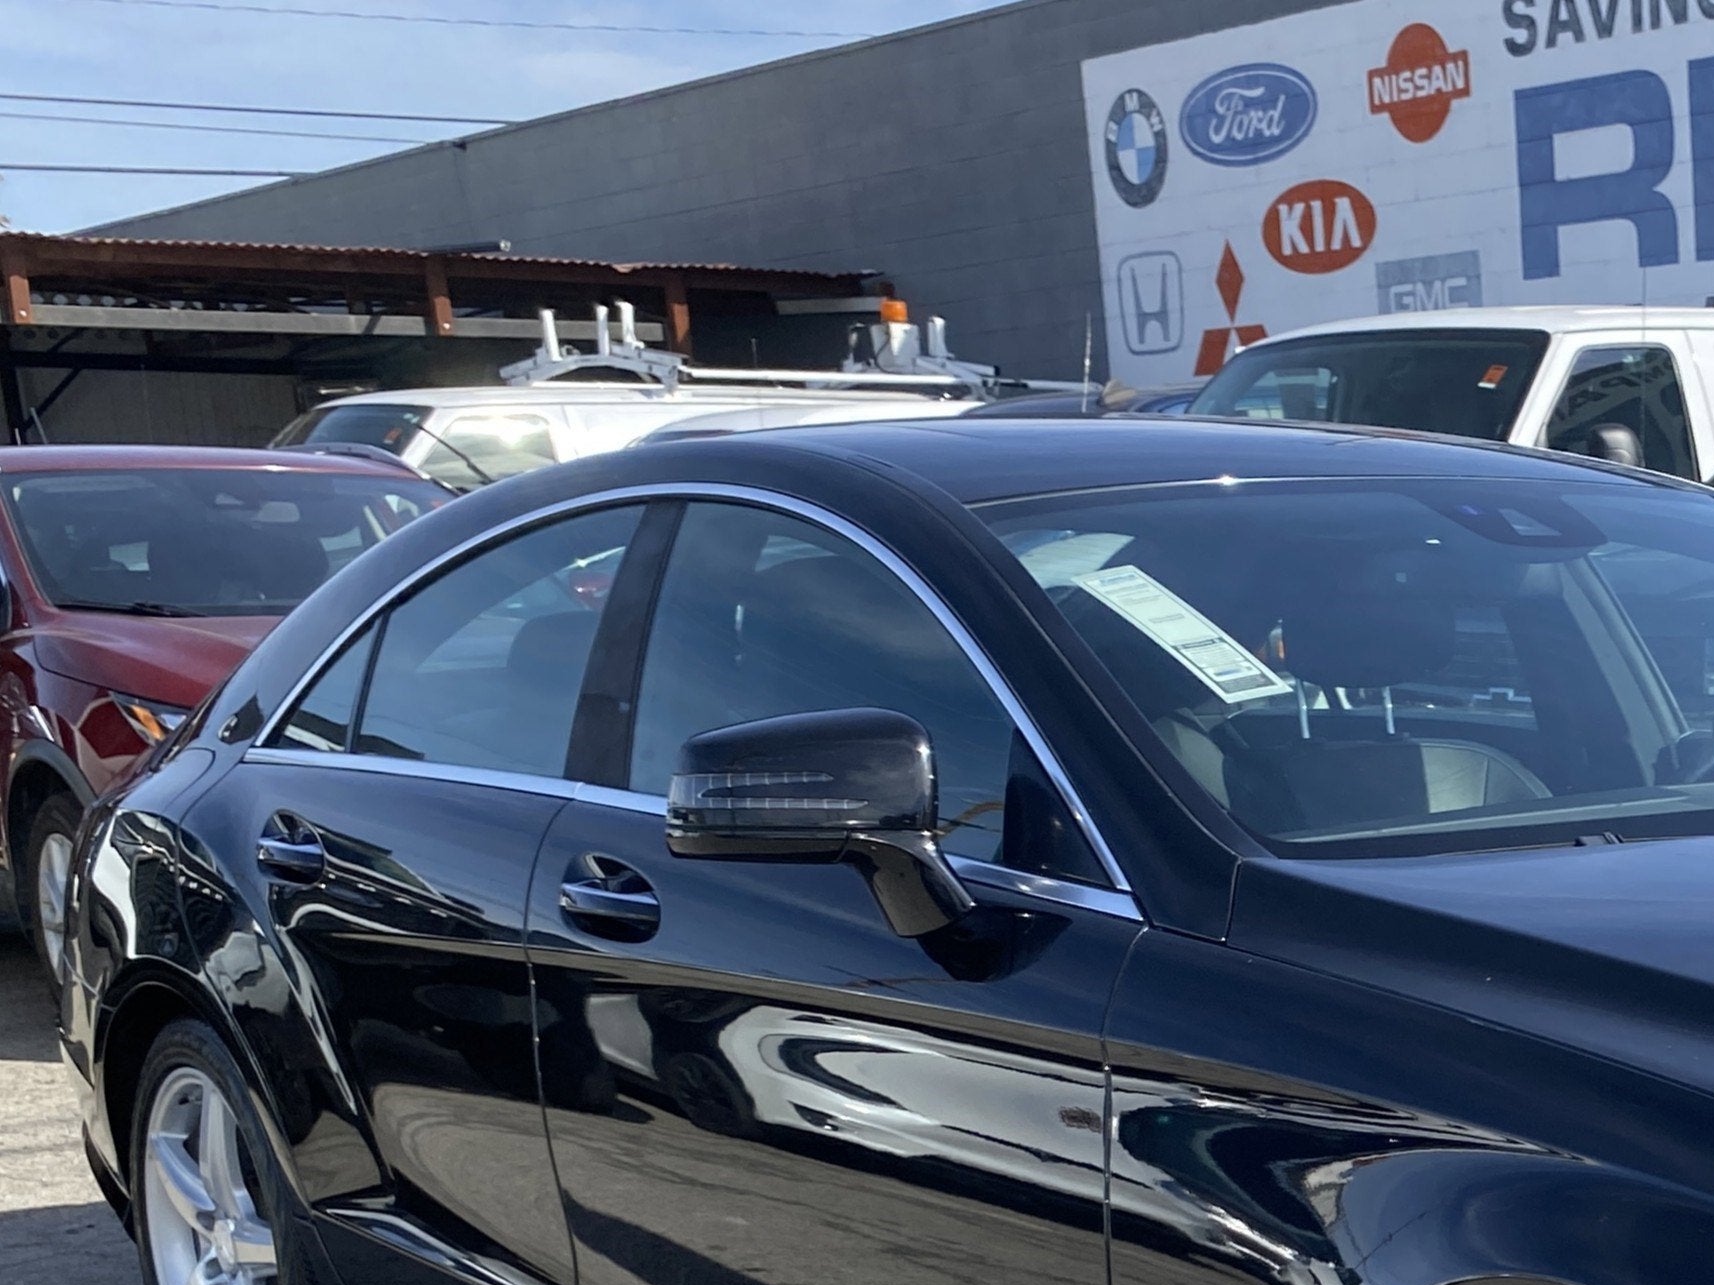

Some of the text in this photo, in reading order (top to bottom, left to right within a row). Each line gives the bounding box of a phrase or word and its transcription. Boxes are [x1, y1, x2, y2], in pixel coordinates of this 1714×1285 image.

[1373, 60, 1465, 106] NISSAN
[1208, 86, 1286, 144] Ford
[1278, 196, 1362, 256] KIA
[1389, 276, 1469, 313] GMC
